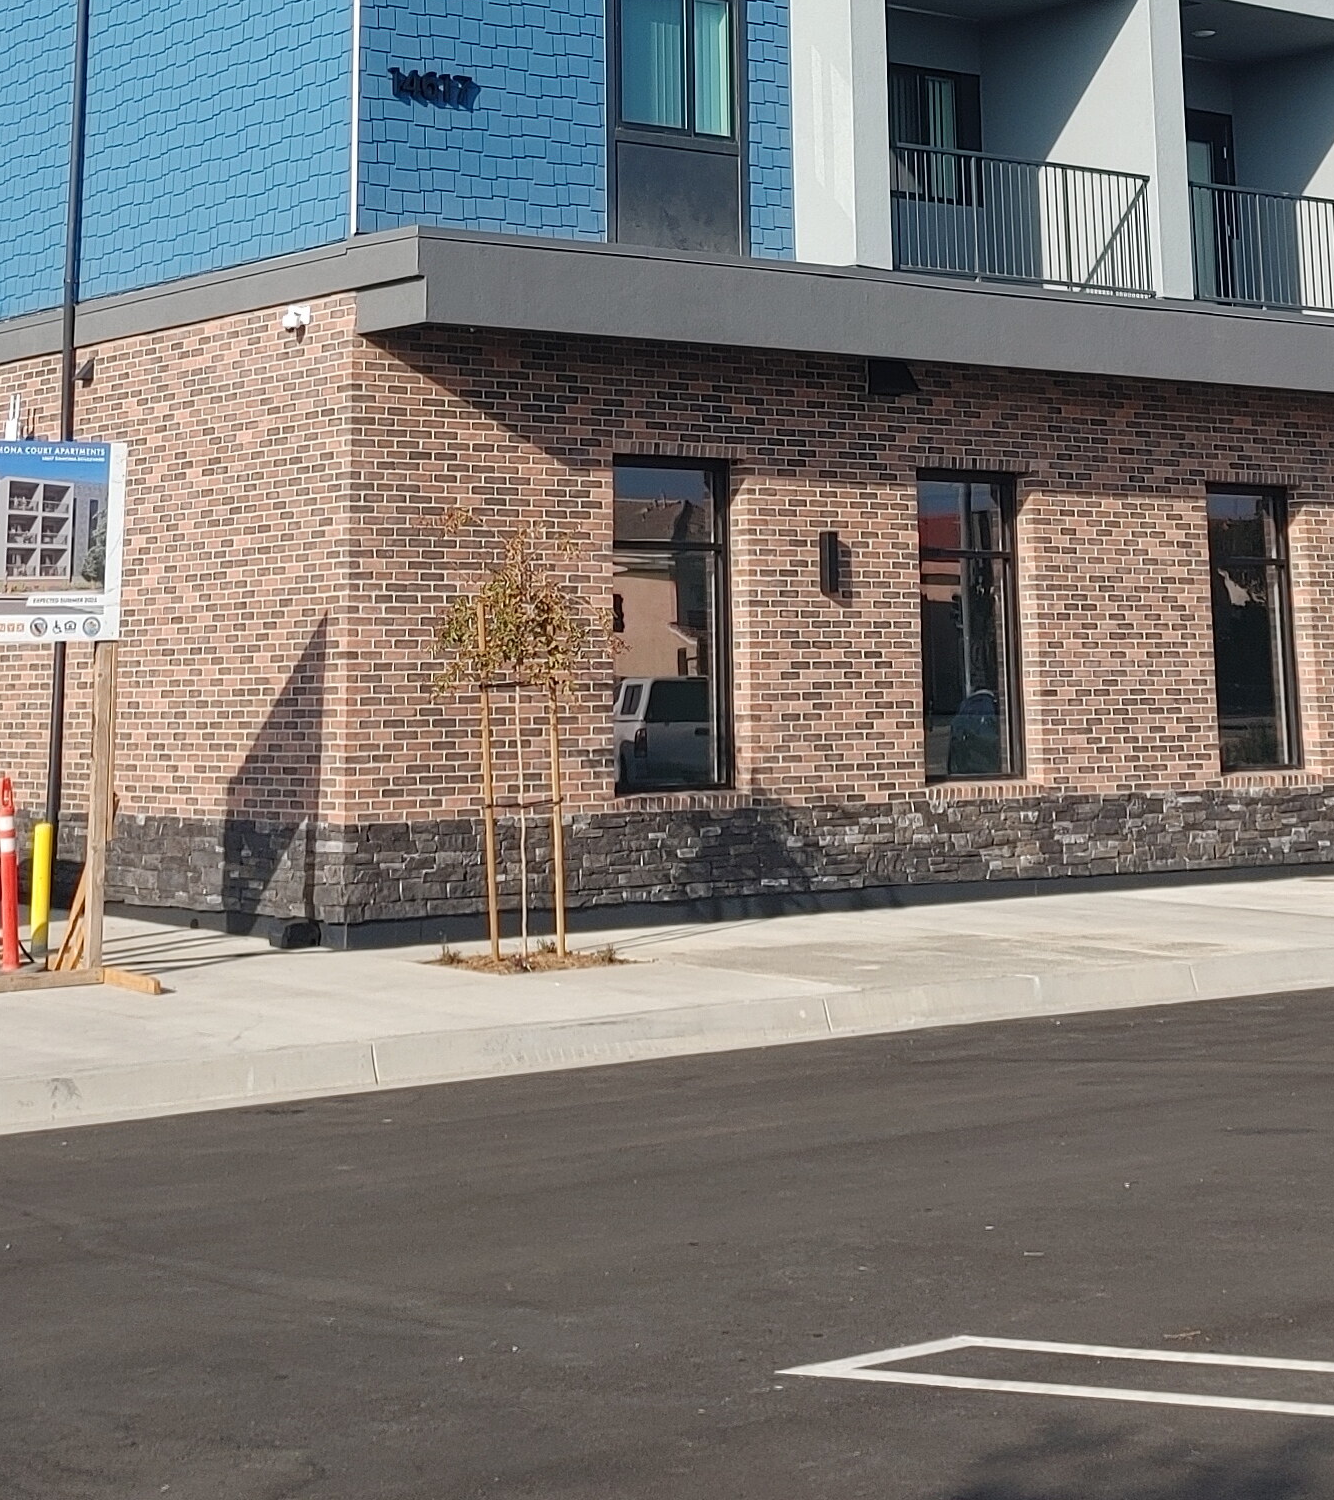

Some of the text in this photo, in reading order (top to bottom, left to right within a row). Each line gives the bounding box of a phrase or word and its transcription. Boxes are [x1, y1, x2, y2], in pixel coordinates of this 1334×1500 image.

[387, 67, 475, 107] 14617
[25, 446, 53, 455] COURT
[54, 447, 106, 456] APARTMENTS
